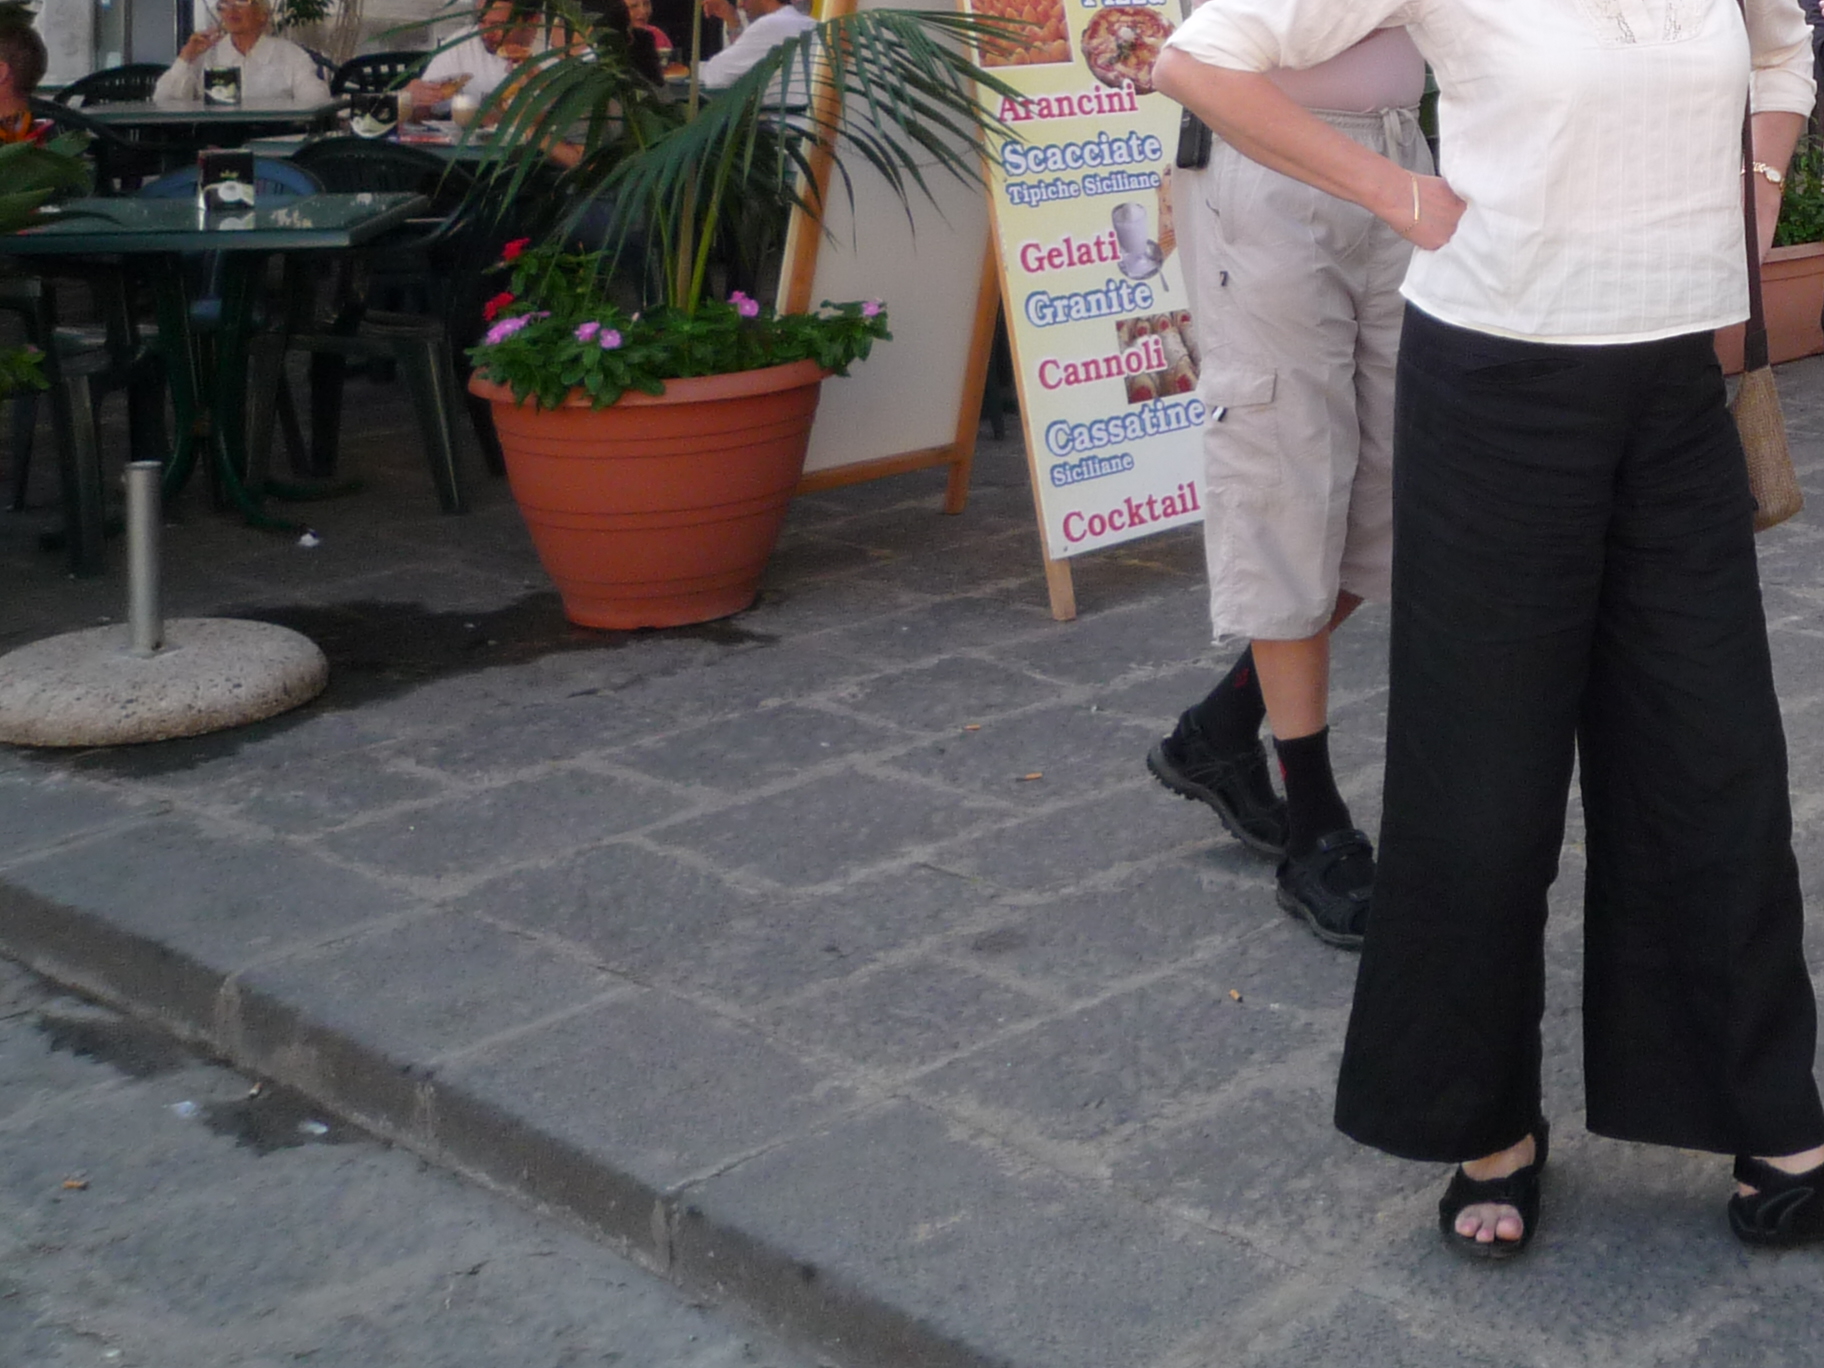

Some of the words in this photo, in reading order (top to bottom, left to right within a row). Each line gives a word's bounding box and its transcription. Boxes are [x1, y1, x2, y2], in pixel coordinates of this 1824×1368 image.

[999, 83, 1139, 122] Arancini
[1000, 131, 1164, 176] Scacciate
[1005, 176, 1081, 206] Tipiche
[1082, 170, 1161, 196] Siciliane
[1019, 231, 1121, 273] Gelati
[1025, 279, 1154, 327] Granite
[1037, 338, 1168, 390] Cannoli
[1045, 399, 1206, 457] Cassatine
[1049, 452, 1135, 487] Siciliane
[1062, 481, 1202, 543] Cocktail
